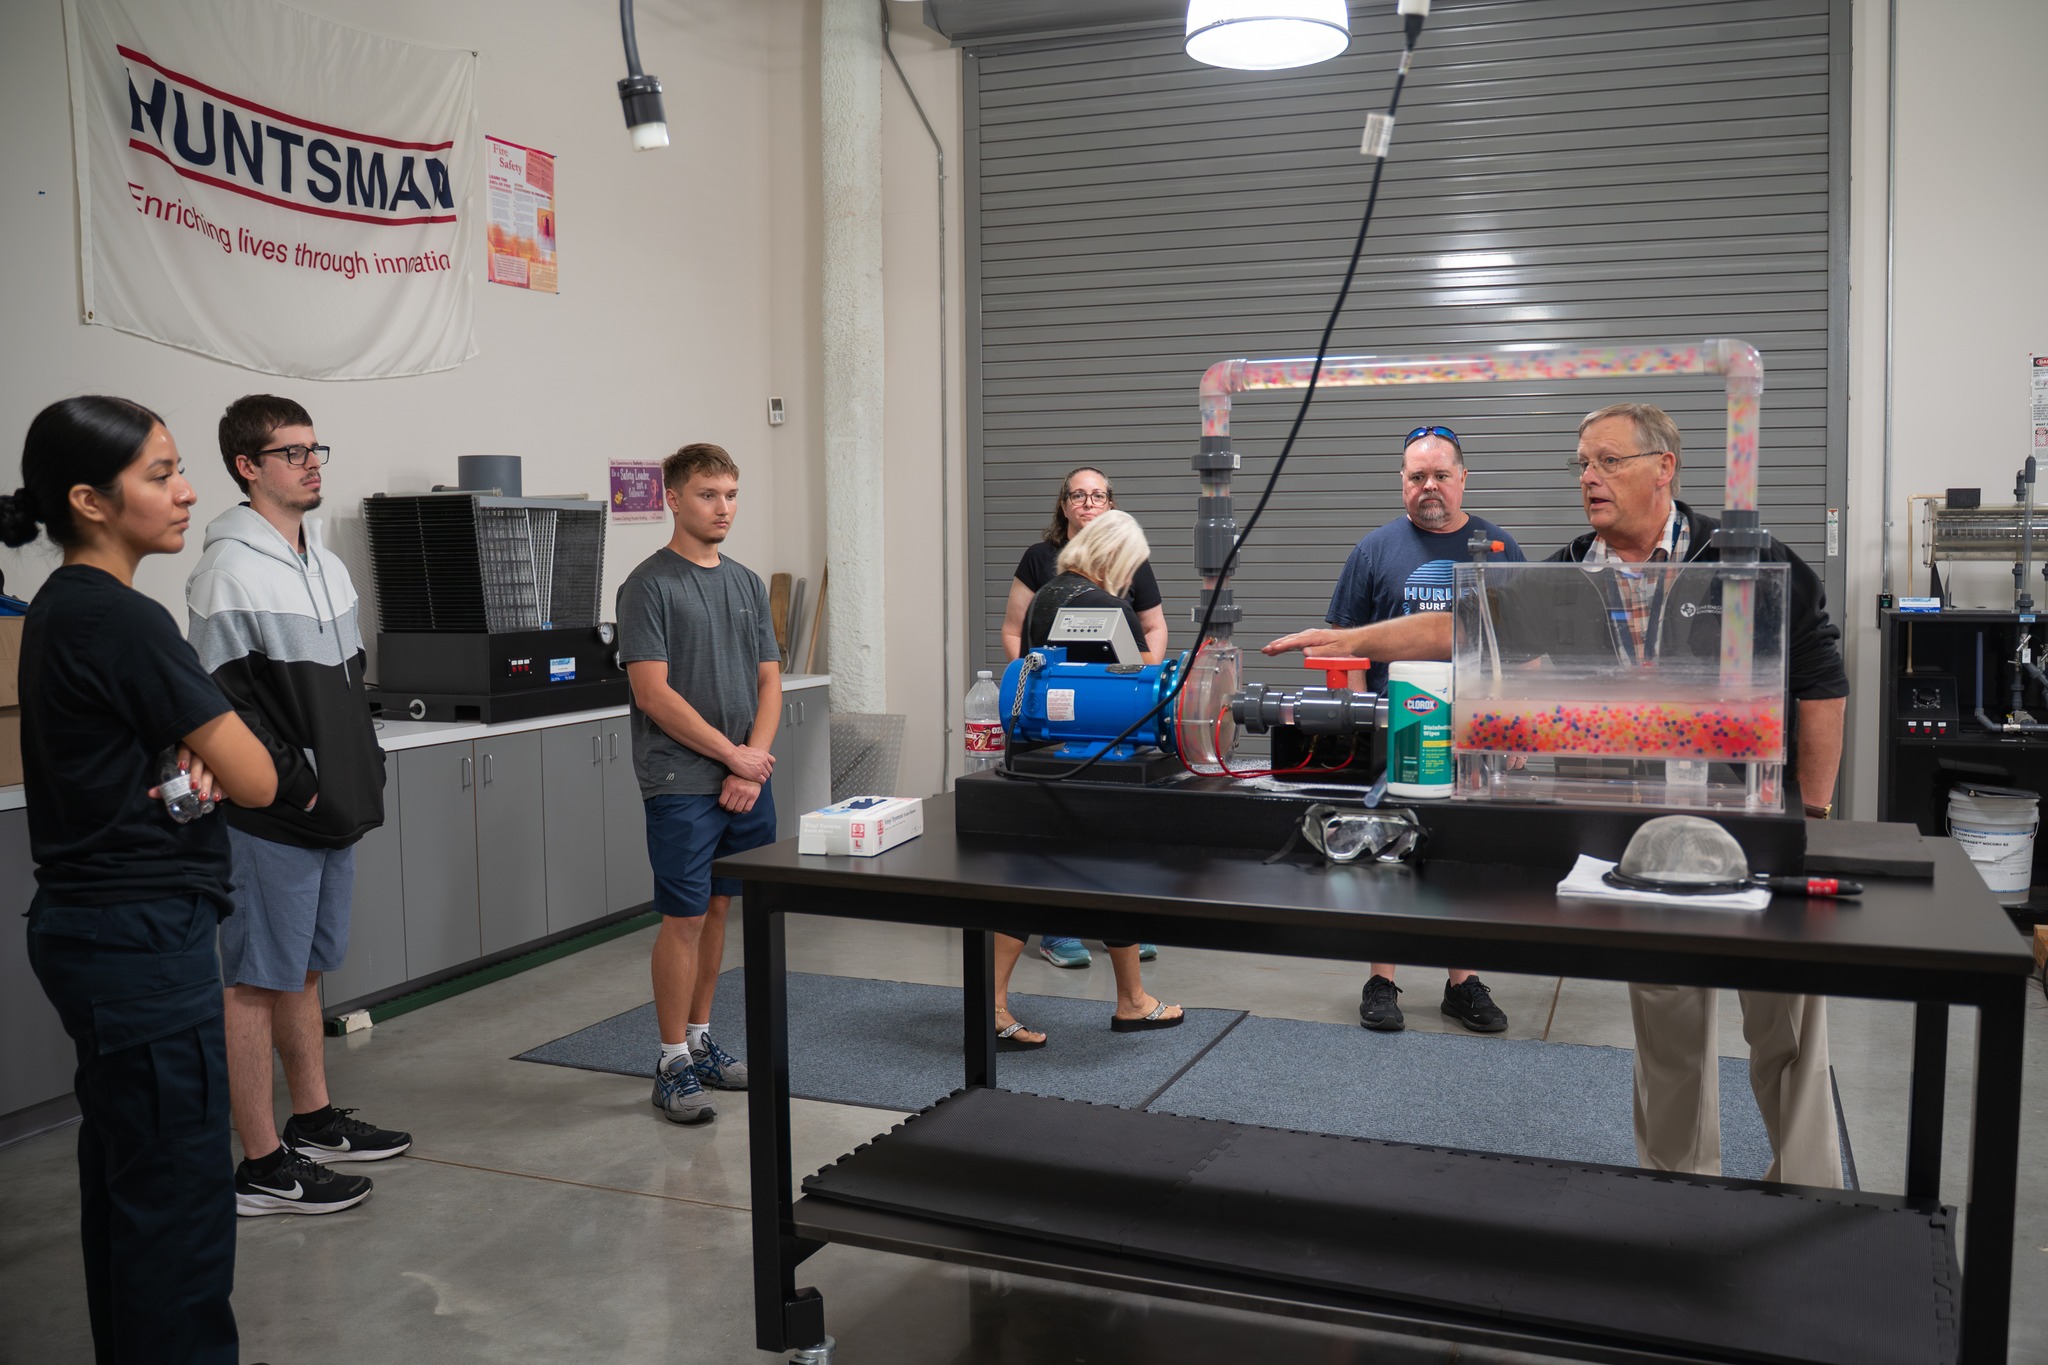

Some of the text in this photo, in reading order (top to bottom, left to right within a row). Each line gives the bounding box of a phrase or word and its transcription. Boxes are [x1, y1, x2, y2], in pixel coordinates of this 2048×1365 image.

[126, 67, 455, 212] HUNTSMAN
[493, 143, 509, 157] Fire
[499, 157, 522, 175] Safety
[127, 181, 232, 254] Enriching
[238, 227, 288, 263] lives
[295, 243, 369, 279] through
[1419, 602, 1446, 611] SURF
[1407, 700, 1435, 710] CLOROX
[855, 840, 862, 848] L
